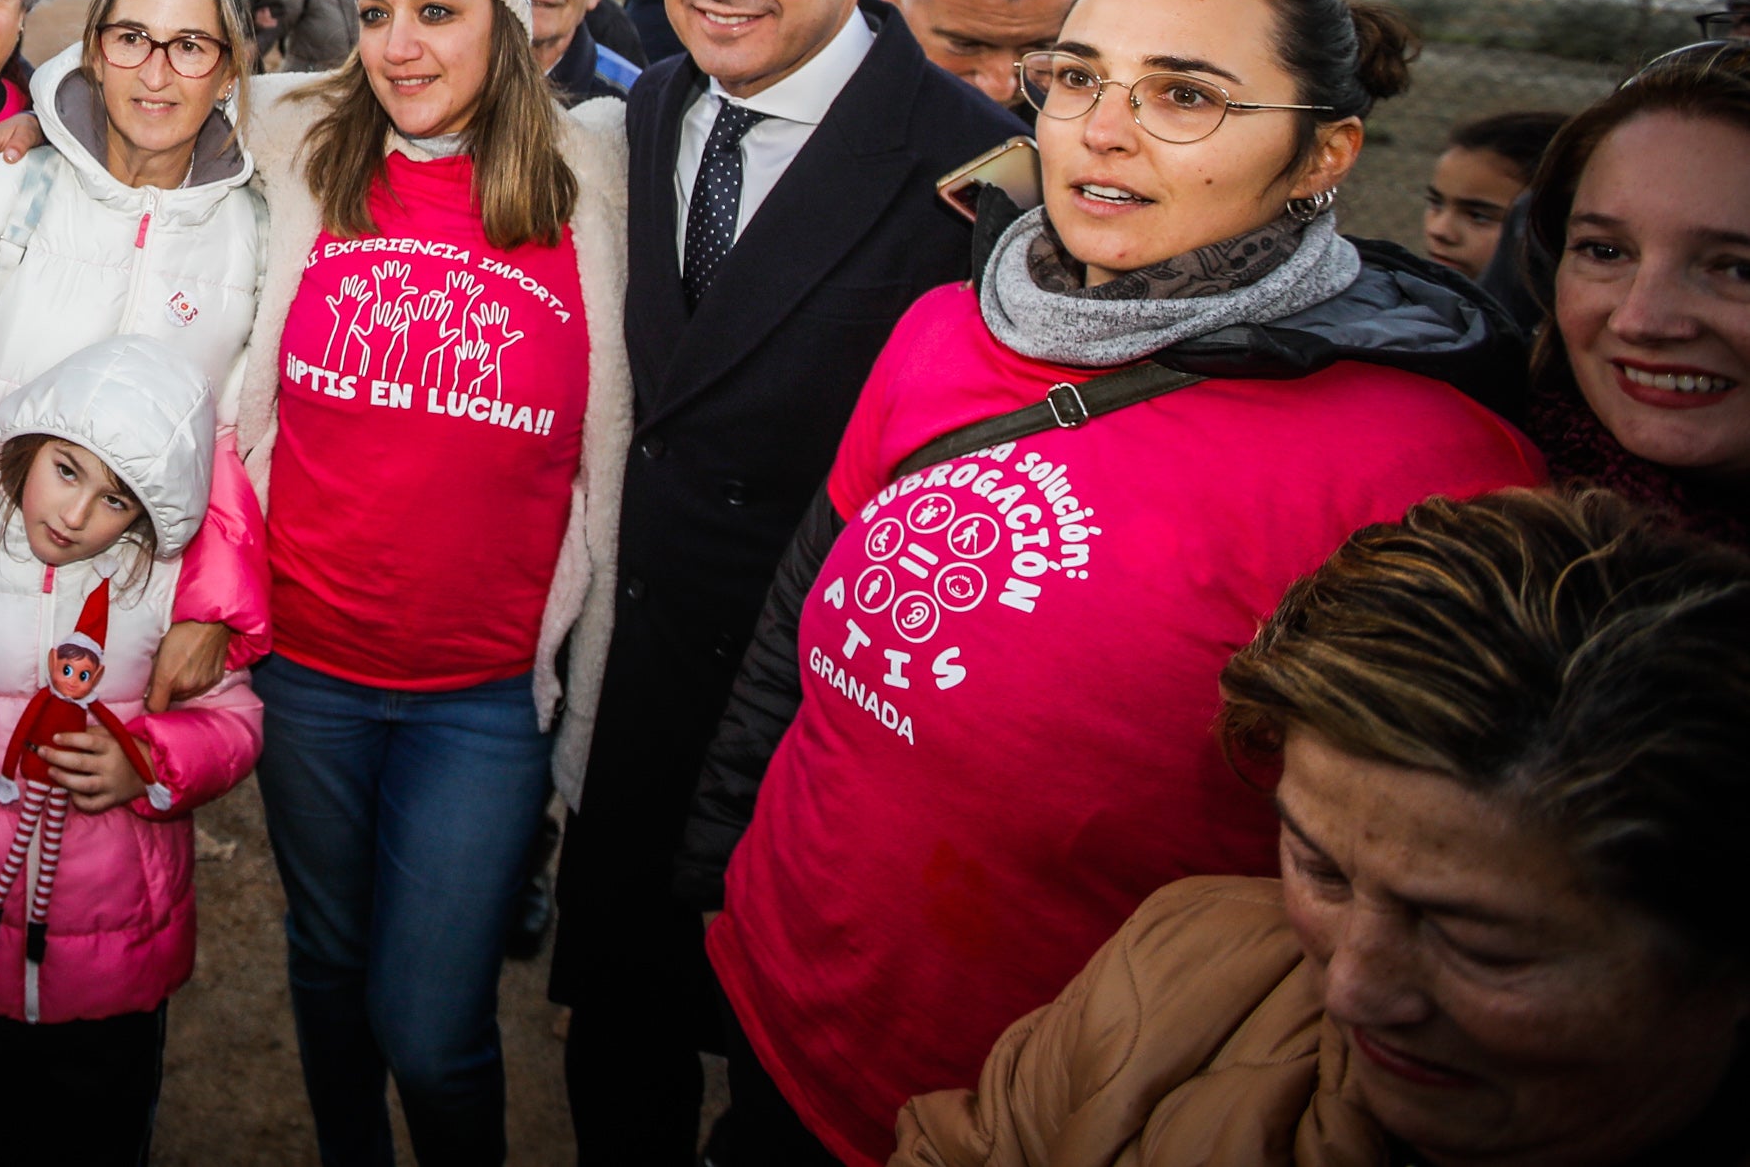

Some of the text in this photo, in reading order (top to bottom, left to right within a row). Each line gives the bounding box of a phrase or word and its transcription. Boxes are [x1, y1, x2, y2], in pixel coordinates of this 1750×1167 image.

[324, 236, 471, 264] EXPERIENCIA
[477, 256, 572, 325] IMPORTA
[369, 379, 414, 410] EN
[427, 386, 556, 437] LUCHA!!
[860, 463, 1063, 614] SUBROGACIÓN
[1015, 451, 1103, 581] solución:
[808, 646, 915, 746] GRANADA
